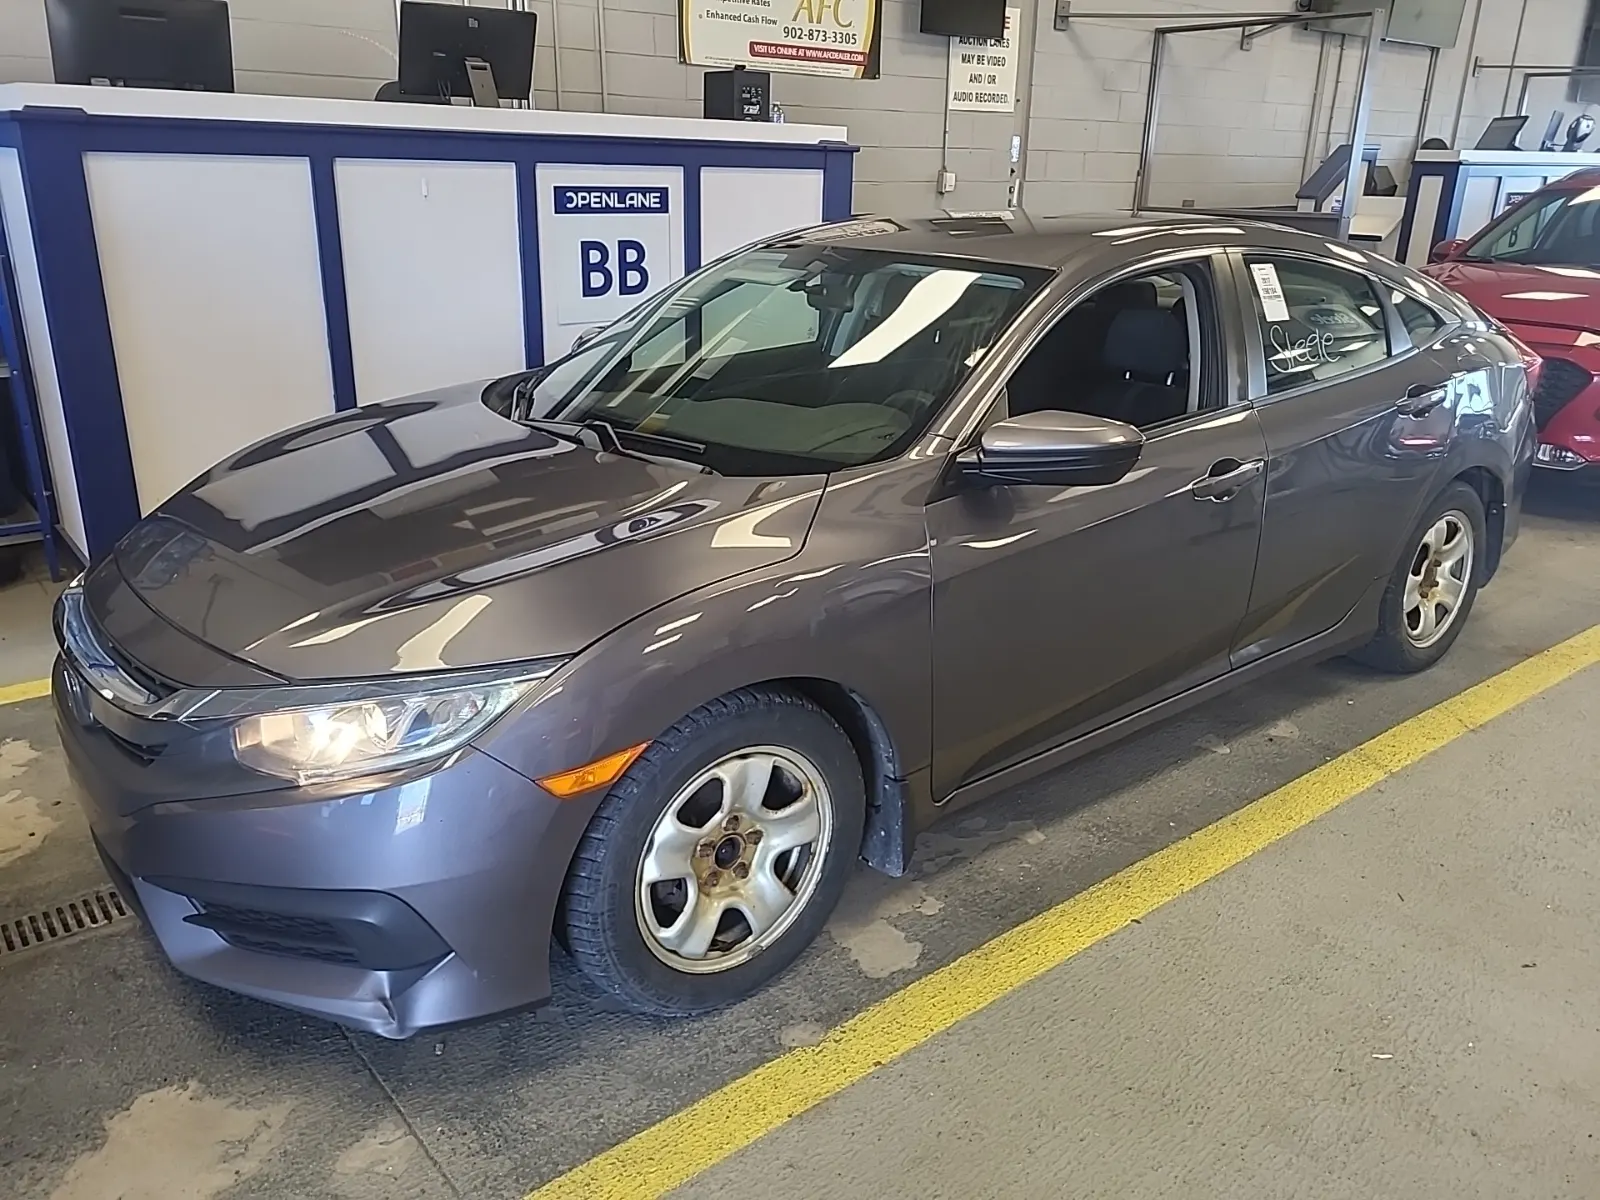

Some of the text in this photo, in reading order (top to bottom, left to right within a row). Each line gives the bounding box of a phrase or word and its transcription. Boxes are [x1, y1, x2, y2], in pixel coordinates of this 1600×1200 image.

[706, 9, 778, 26] Enhanced Cash Flow
[791, 0, 853, 28] AFC
[783, 26, 857, 45] 902-873-3305
[958, 36, 988, 47] AUCTION
[753, 44, 864, 62] VISIT US ONLINE AT WWW.AFCDEALER.COM
[961, 53, 1007, 67] MAY BE VIDEO
[969, 73, 983, 84] AND
[987, 74, 997, 85] OR
[953, 91, 1009, 104] AUDIO RECORDED.
[580, 239, 650, 298] BB
